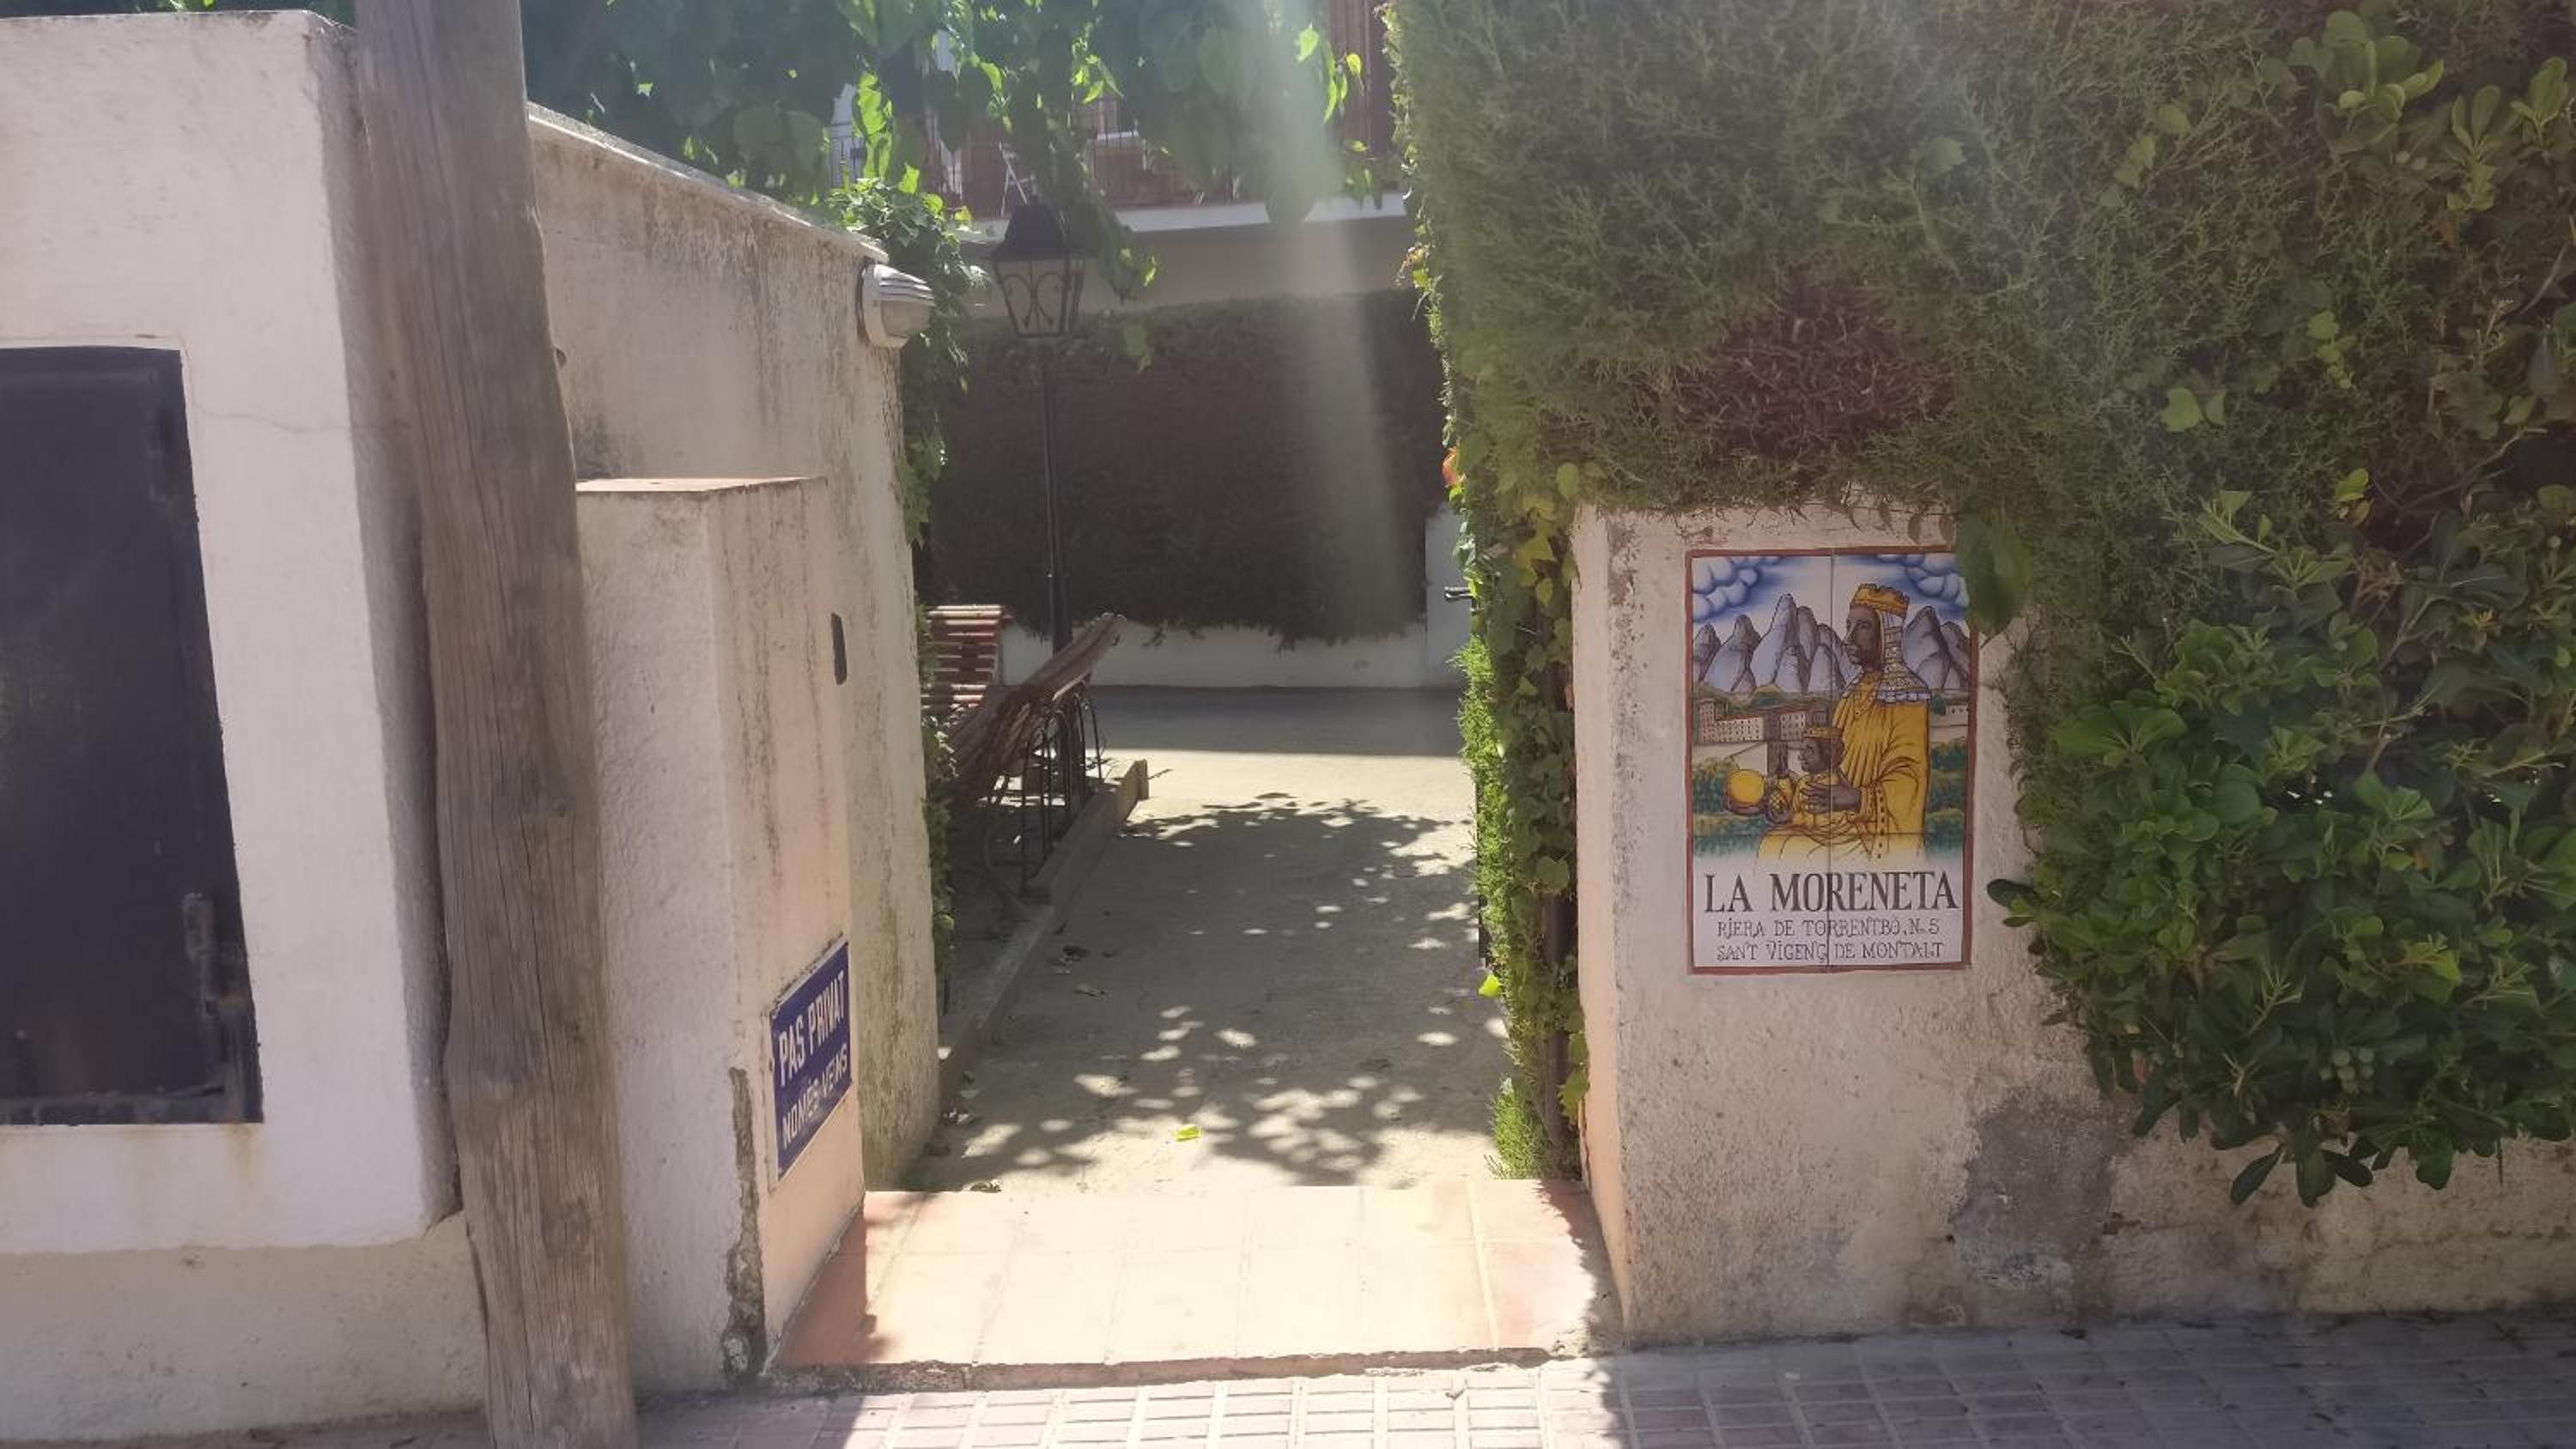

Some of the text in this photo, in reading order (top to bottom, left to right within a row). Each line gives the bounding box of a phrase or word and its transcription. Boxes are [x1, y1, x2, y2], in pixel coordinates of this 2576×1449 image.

[1704, 871, 1959, 912] LA MORENETA
[1774, 919, 1795, 937] DE
[1717, 943, 1758, 961] SANT
[1834, 943, 1856, 959] DE
[1862, 941, 1943, 958] MONTALT
[779, 970, 845, 1086] PAS PRIVAT
